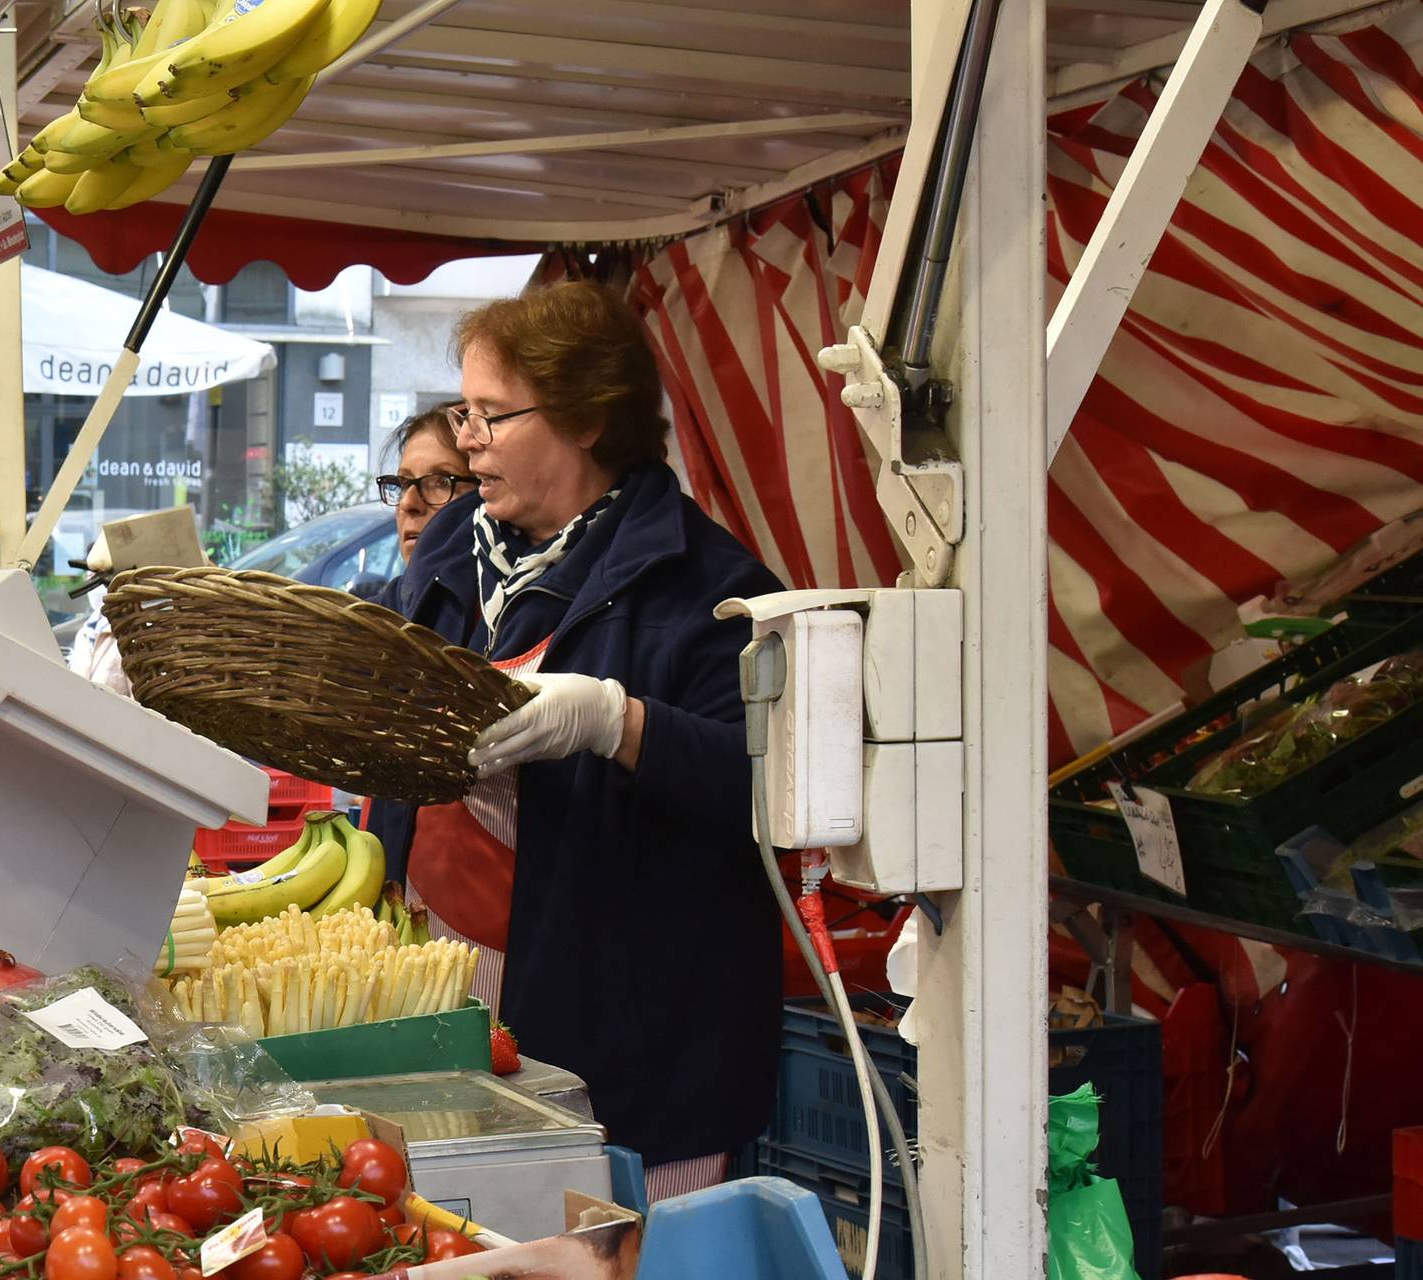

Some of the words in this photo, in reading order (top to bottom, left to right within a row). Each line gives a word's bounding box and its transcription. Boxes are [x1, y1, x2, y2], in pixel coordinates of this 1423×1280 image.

[40, 354, 112, 385] dean
[146, 360, 228, 387] david
[322, 407, 335, 420] 12
[98, 459, 140, 476] dean
[142, 463, 154, 476] &
[155, 459, 202, 477] david
[144, 477, 170, 487] fresh
